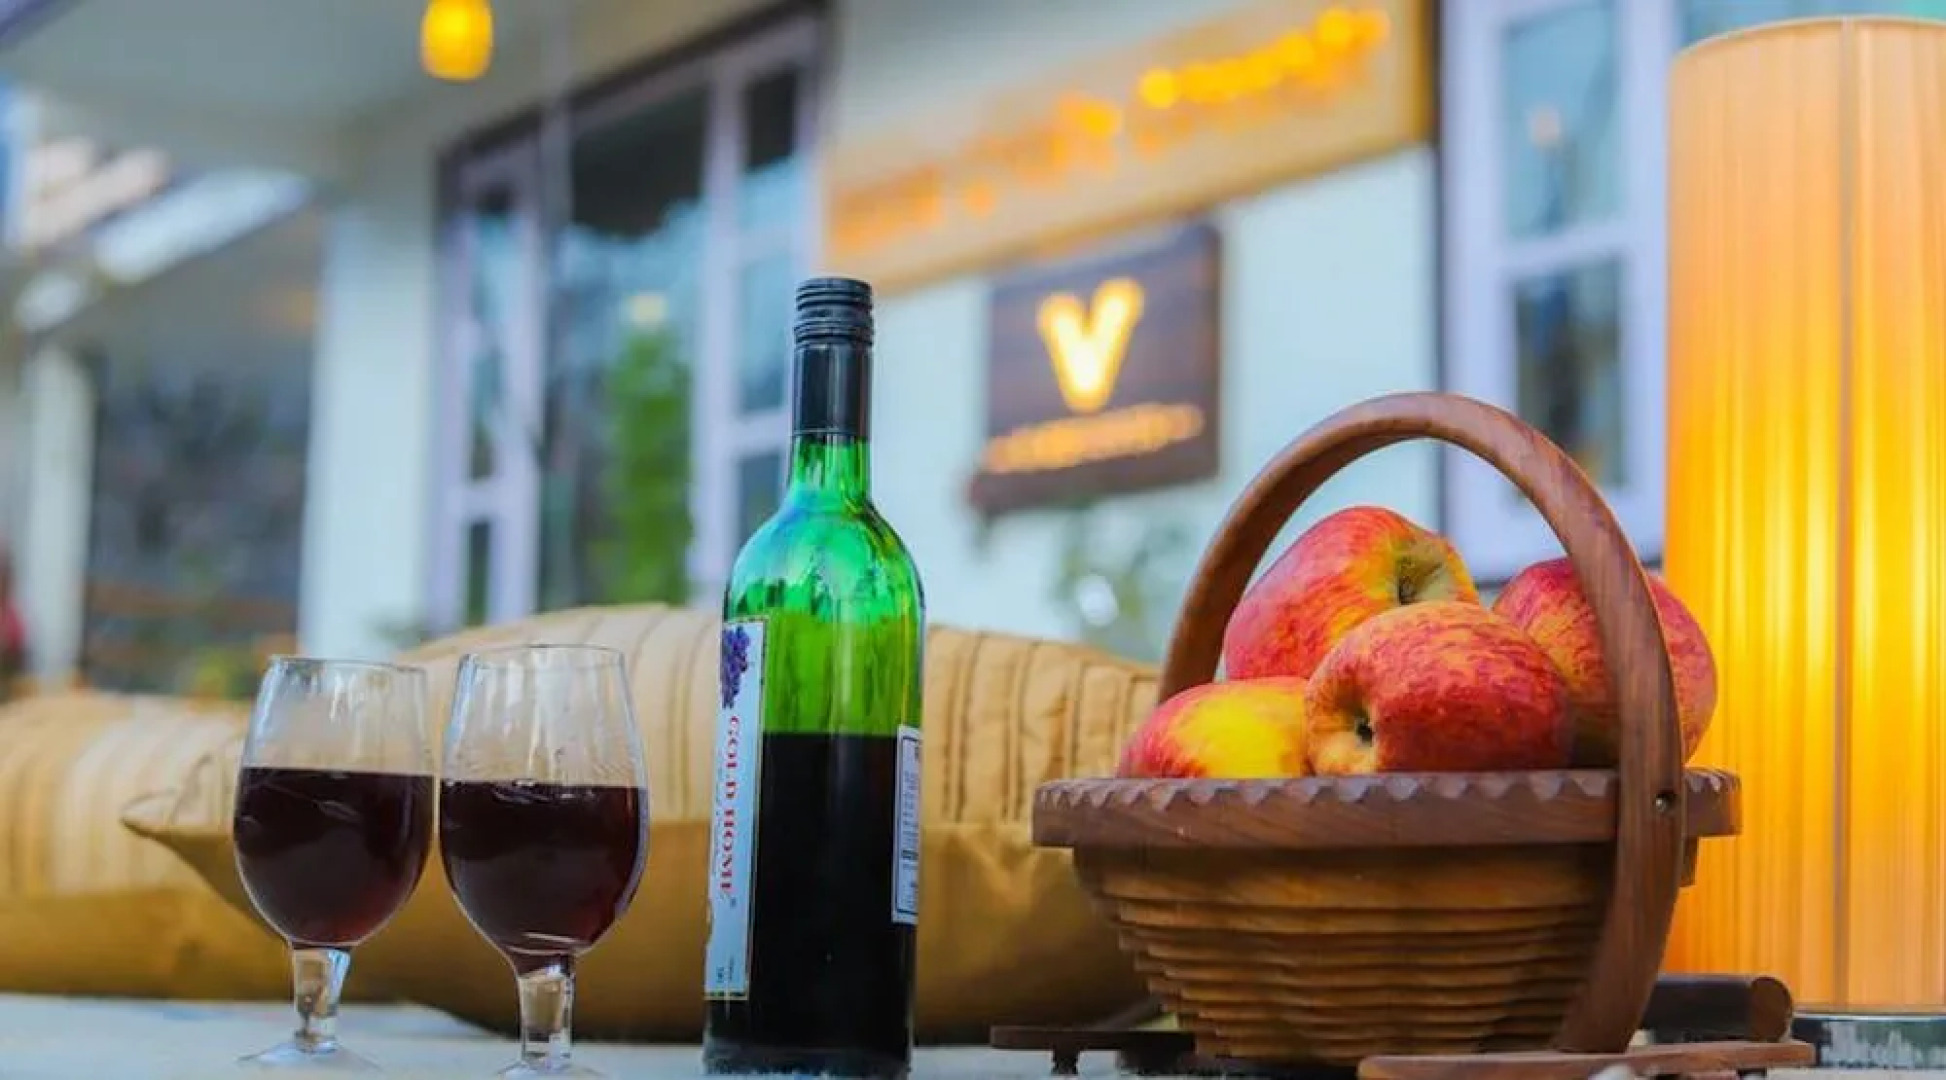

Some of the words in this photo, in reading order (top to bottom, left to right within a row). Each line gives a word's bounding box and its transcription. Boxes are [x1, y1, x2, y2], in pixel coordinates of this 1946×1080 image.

[1037, 278, 1144, 413] V
[726, 715, 740, 799] GOLD
[720, 808, 735, 897] HOME
